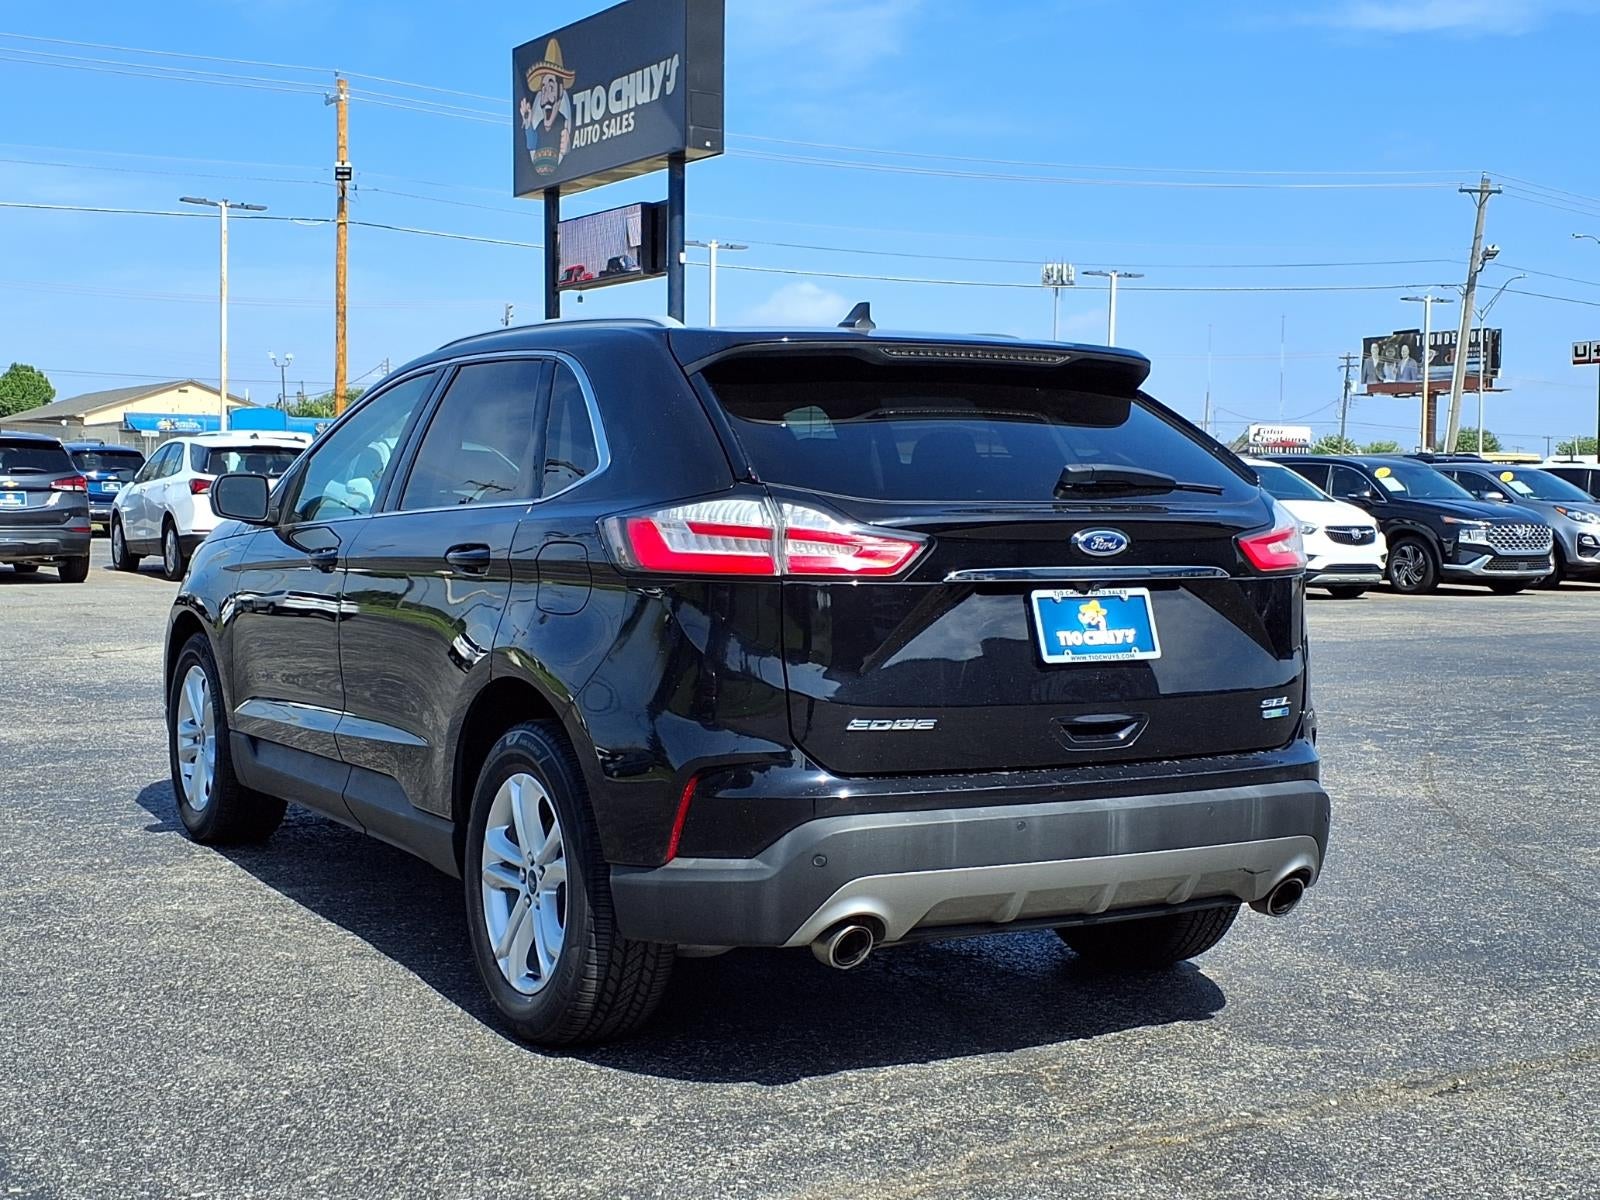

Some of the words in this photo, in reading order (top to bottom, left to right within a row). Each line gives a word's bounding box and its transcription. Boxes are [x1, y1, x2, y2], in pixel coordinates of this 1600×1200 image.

[572, 85, 607, 127] TIO
[608, 53, 680, 115] CHUY'S
[572, 123, 600, 150] AUTO
[602, 111, 636, 141] SALES
[1090, 535, 1117, 550] Ford
[1056, 630, 1083, 646] TIO
[1260, 696, 1291, 708] SEL
[846, 719, 938, 731] EDGE
